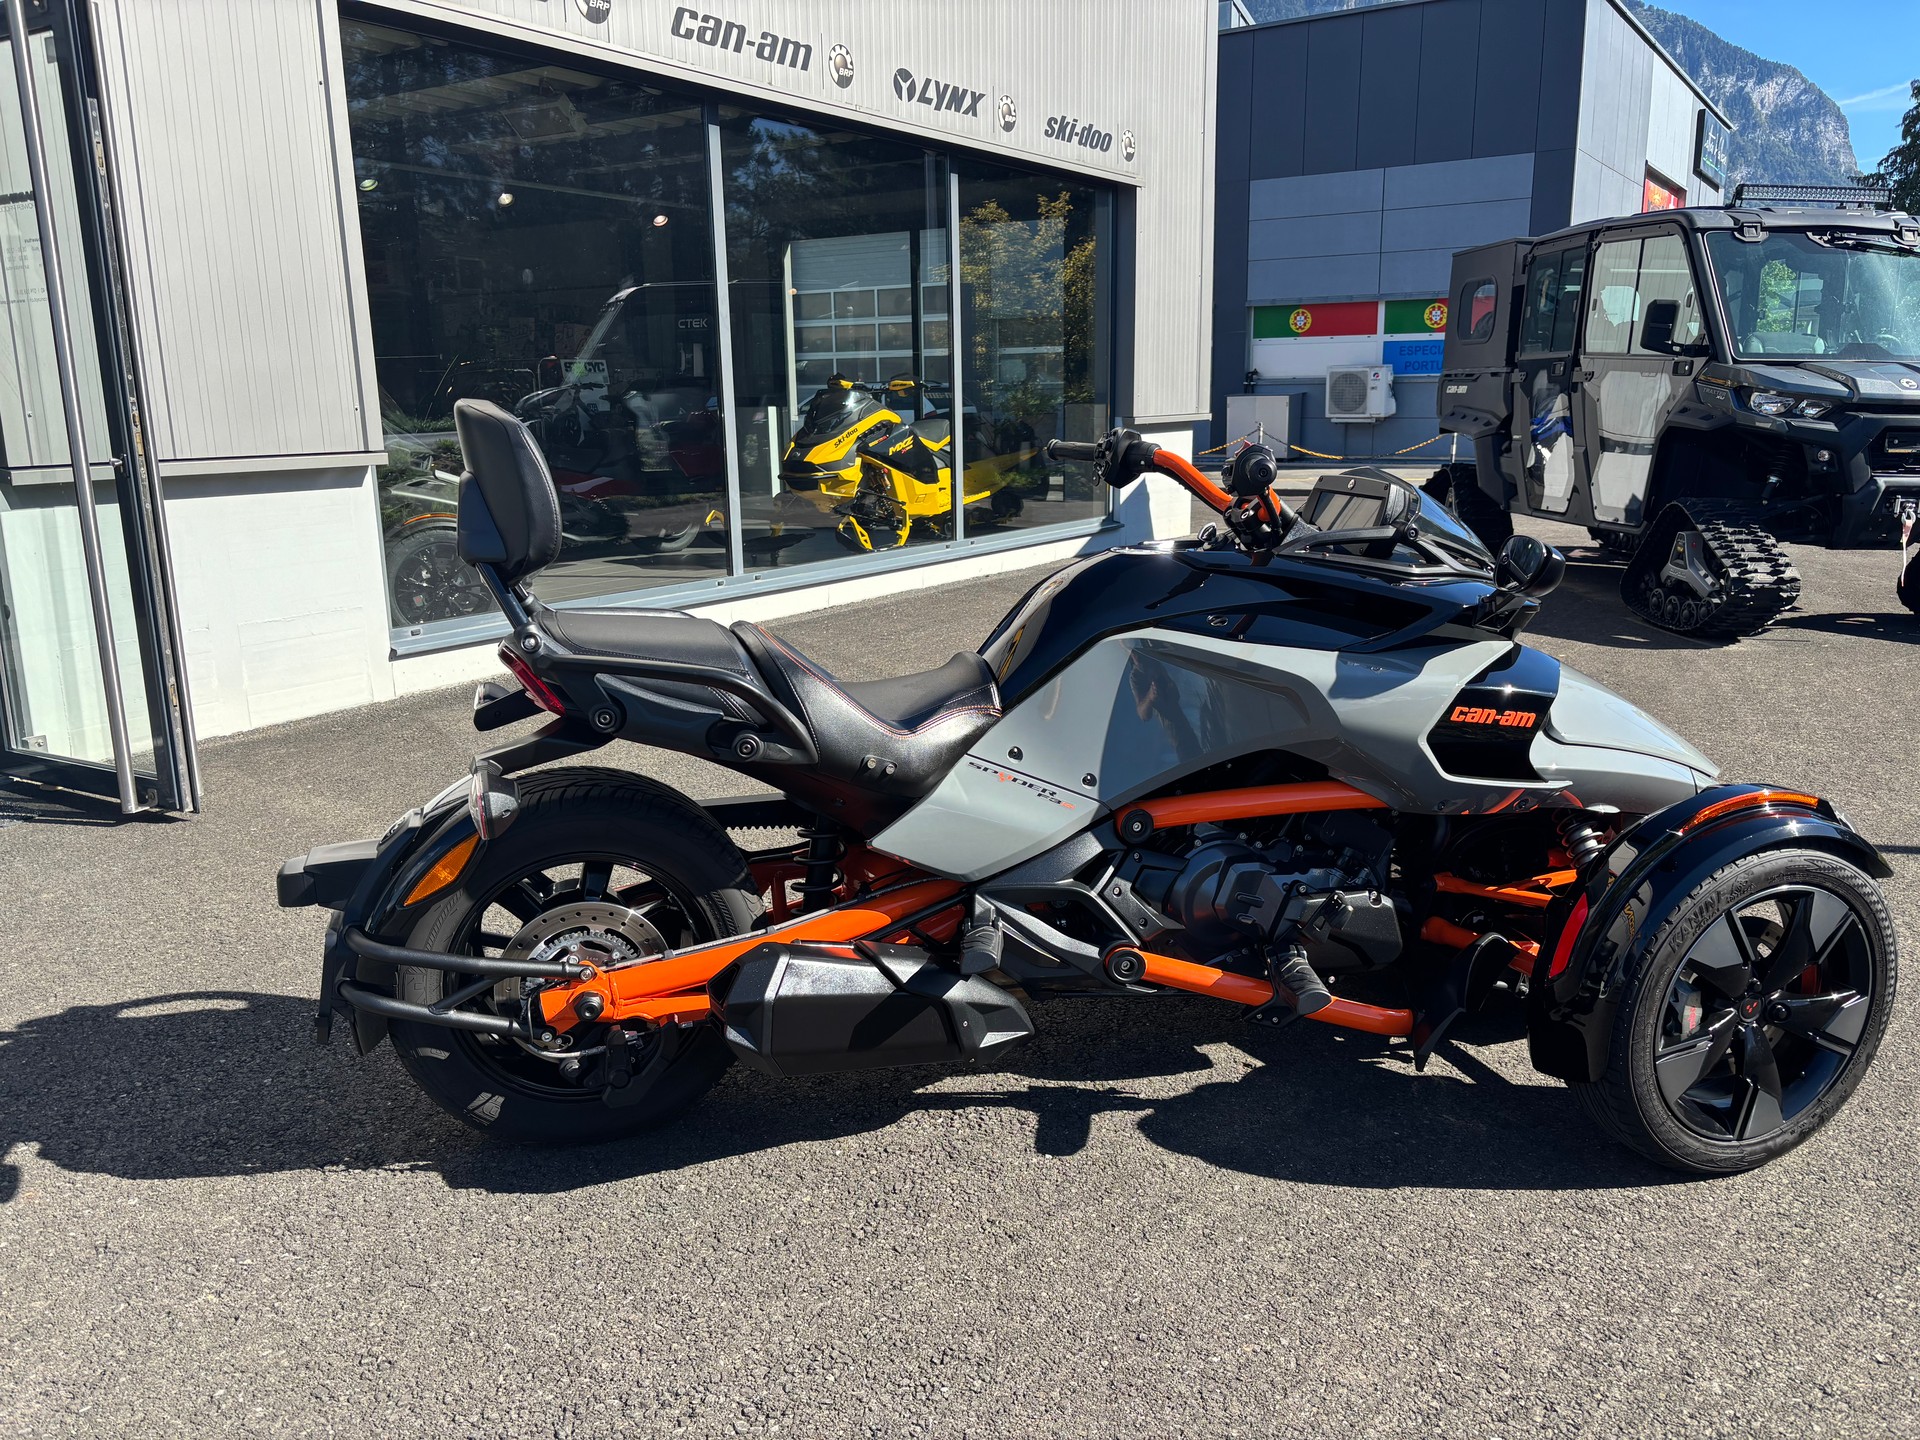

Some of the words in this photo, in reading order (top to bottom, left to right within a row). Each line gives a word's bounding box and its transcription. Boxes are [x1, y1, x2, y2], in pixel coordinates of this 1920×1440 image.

[671, 6, 813, 72] can-am
[917, 77, 986, 118] LYNX
[1044, 115, 1113, 152] ski-doo
[678, 318, 708, 329] CTEK
[564, 361, 605, 373] SCYC
[834, 428, 858, 448] ski-doo
[1450, 706, 1536, 728] can-am
